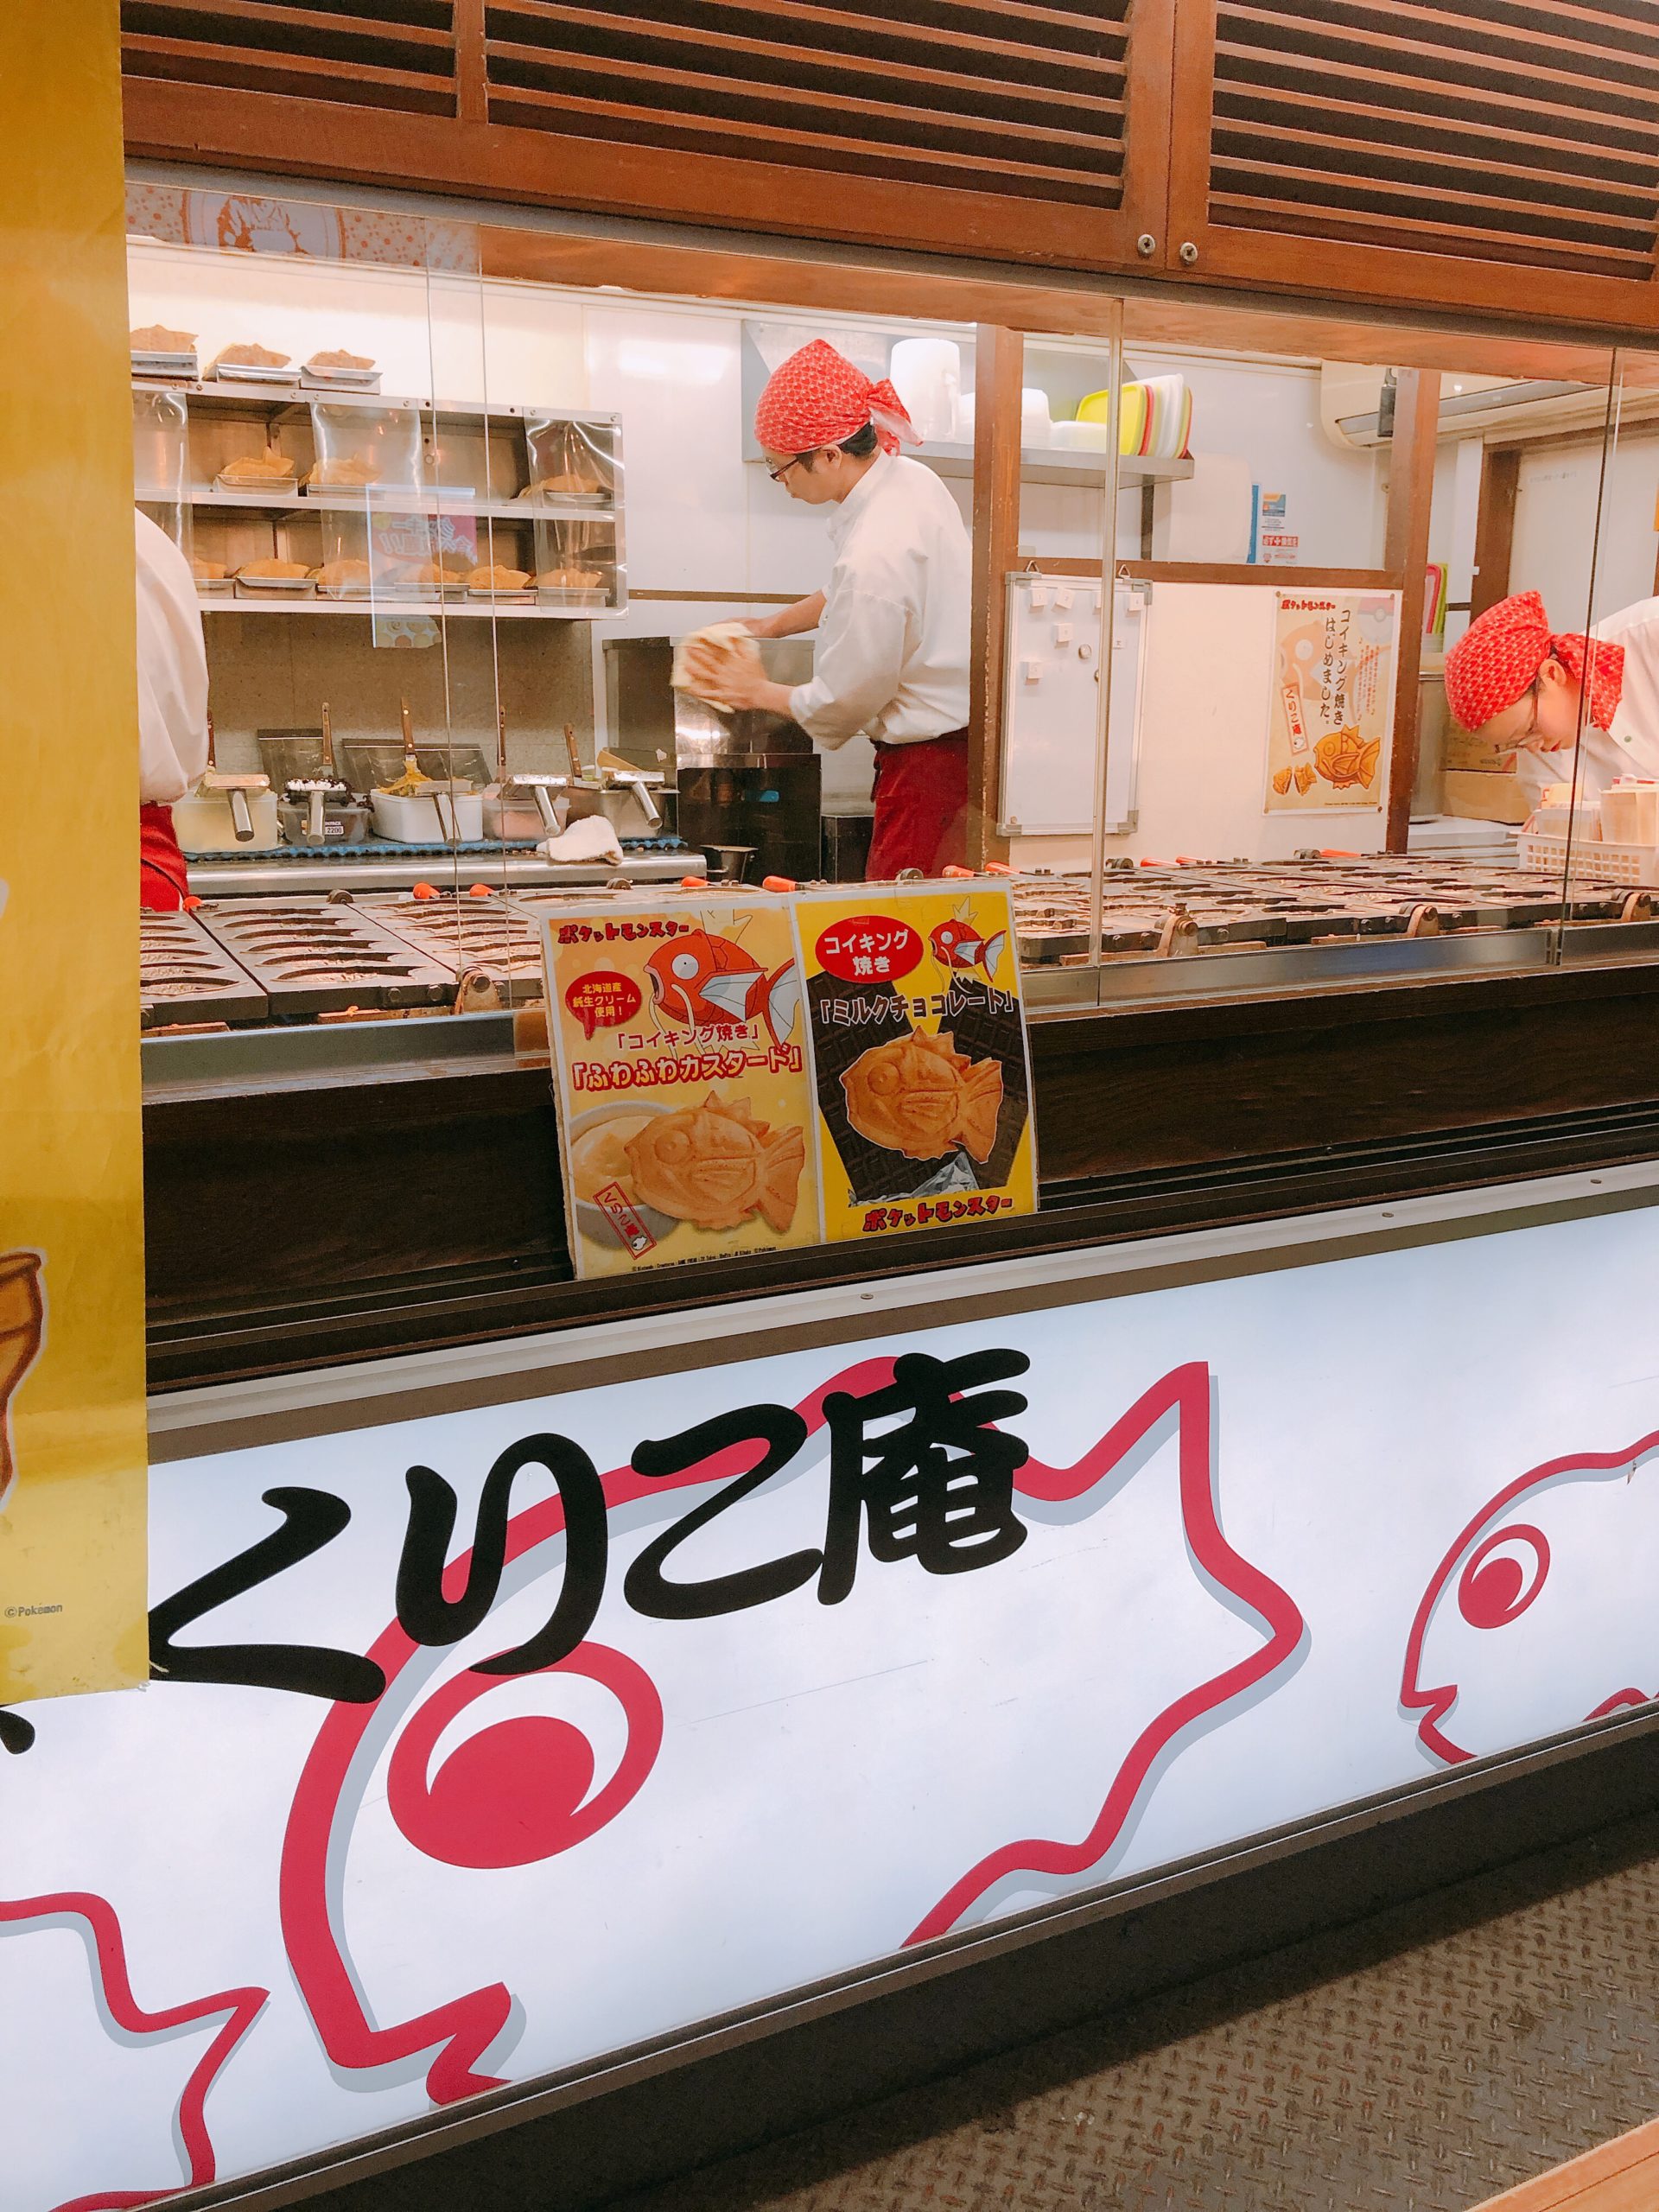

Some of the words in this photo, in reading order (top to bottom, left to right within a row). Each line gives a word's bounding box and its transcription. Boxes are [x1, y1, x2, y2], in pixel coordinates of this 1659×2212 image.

[1333, 609, 1351, 725] コイキング焼き
[558, 921, 690, 944] ポケットモンスター
[823, 929, 909, 955] コイキング
[852, 956, 891, 976] 焼き
[582, 982, 622, 994] 北海道産
[573, 994, 637, 1007] 純生クリーム
[862, 1195, 1013, 1232] ポケットモンスター
[144, 1348, 1030, 1704] くりこ庵
